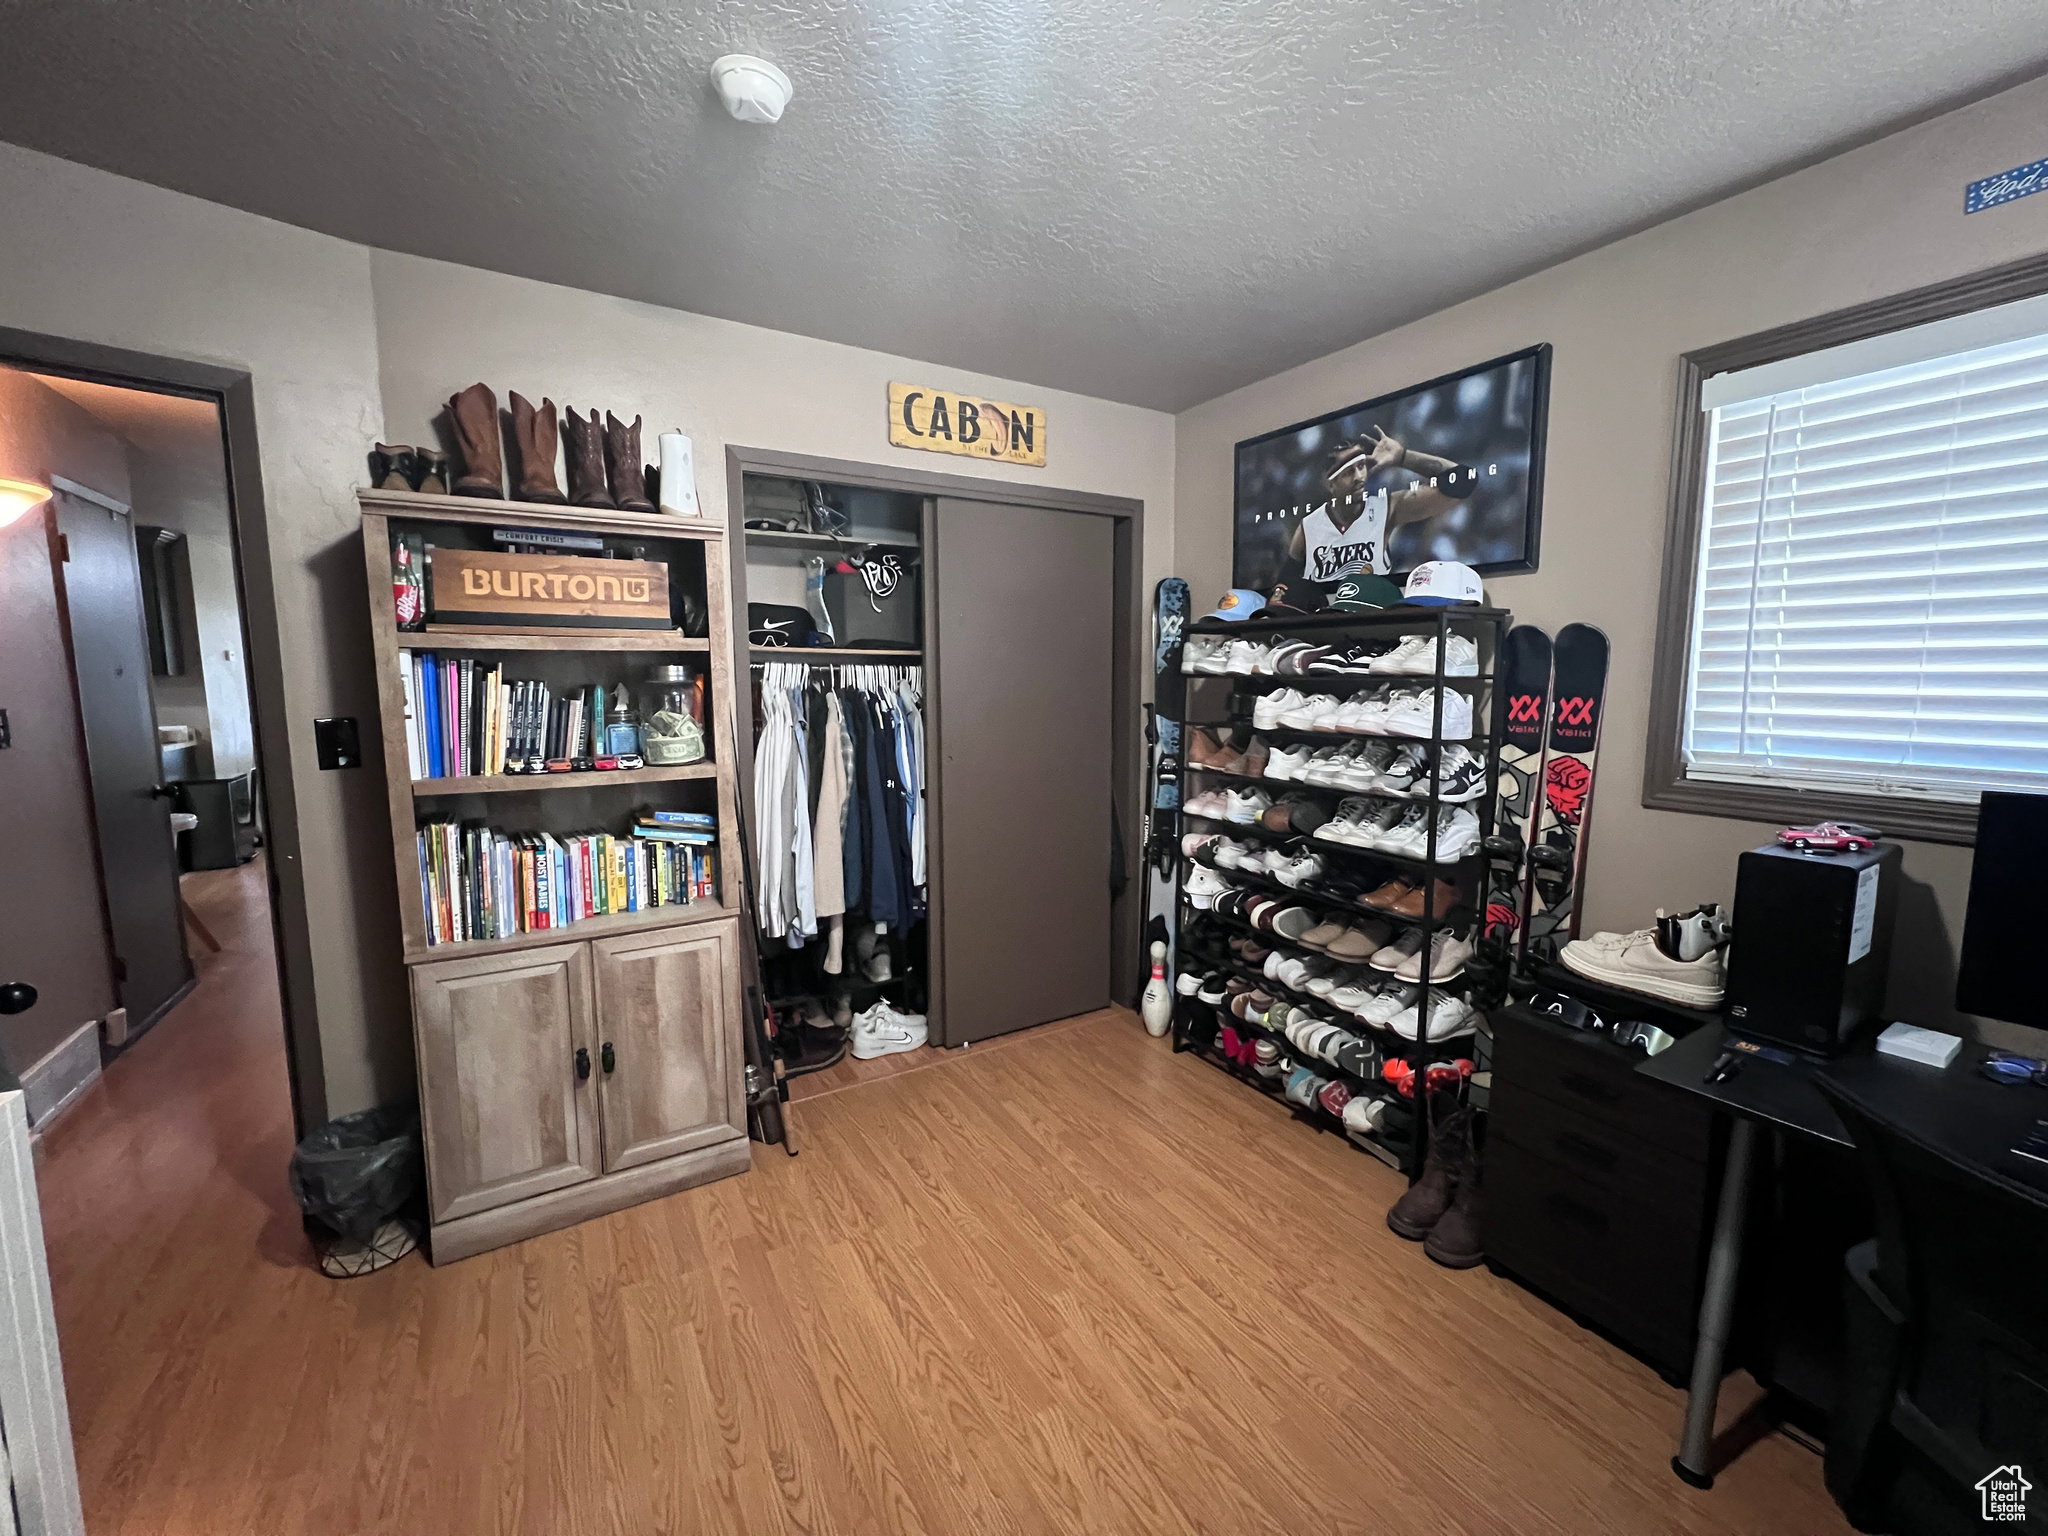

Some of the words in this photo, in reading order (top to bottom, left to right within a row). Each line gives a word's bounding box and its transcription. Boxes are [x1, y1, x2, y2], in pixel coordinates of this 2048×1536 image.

[1980, 167, 2043, 203] God
[1255, 503, 1312, 523] PROVE
[1331, 487, 1387, 507] THEM
[1409, 464, 1497, 492] WRONG
[461, 568, 621, 601] BURTON
[536, 854, 547, 878] NOISY
[537, 881, 549, 909] BABIES
